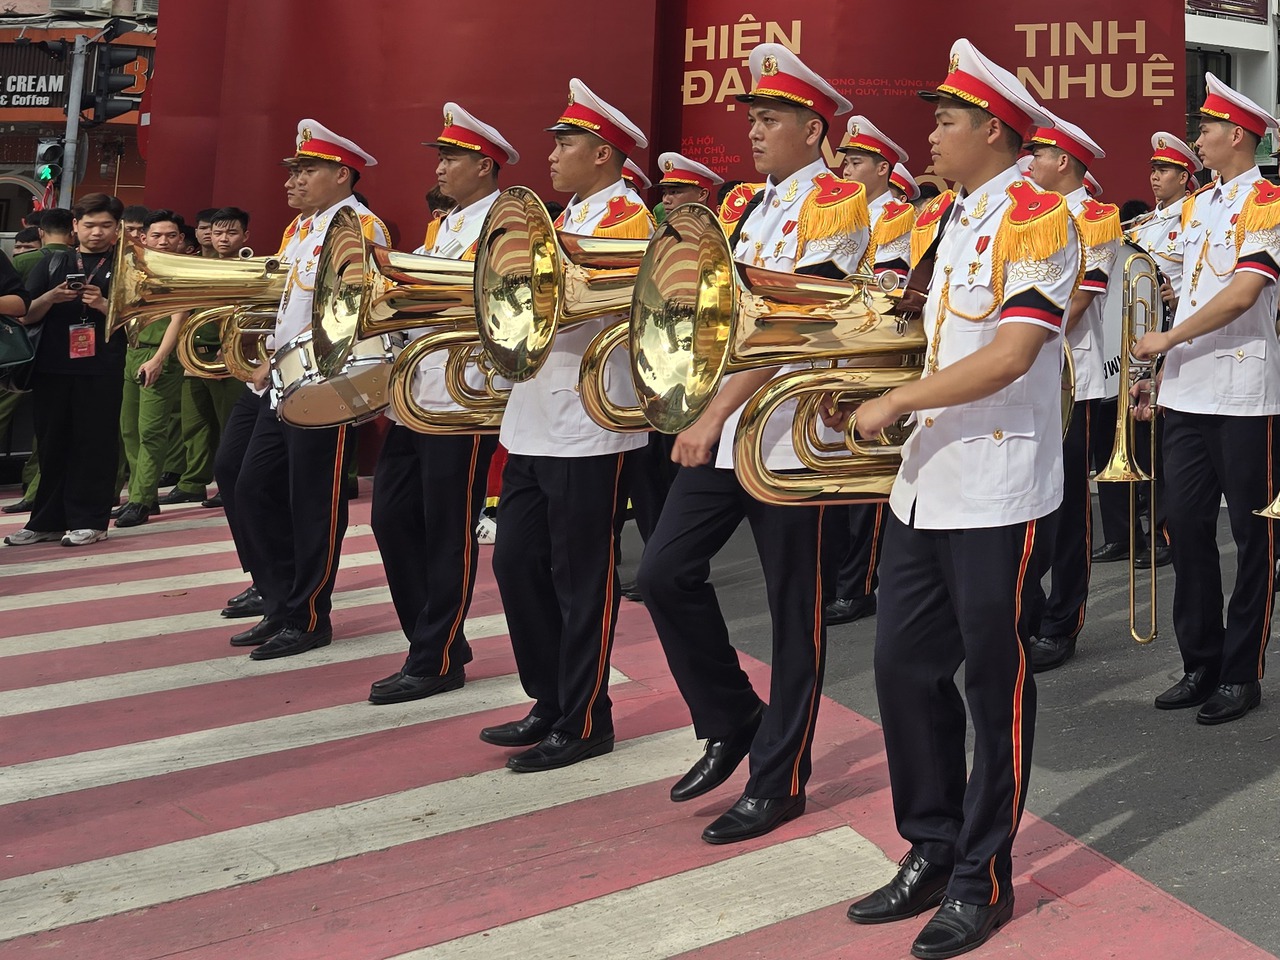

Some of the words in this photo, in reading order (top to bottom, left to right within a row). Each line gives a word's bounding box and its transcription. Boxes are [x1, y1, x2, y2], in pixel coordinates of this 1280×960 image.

[684, 13, 803, 68] HIỆN
[1014, 20, 1146, 58] TINH
[6, 76, 64, 93] CREAM
[681, 67, 753, 112] ĐẠ
[1016, 53, 1175, 106] NHUỆ
[11, 95, 50, 106] Coffee
